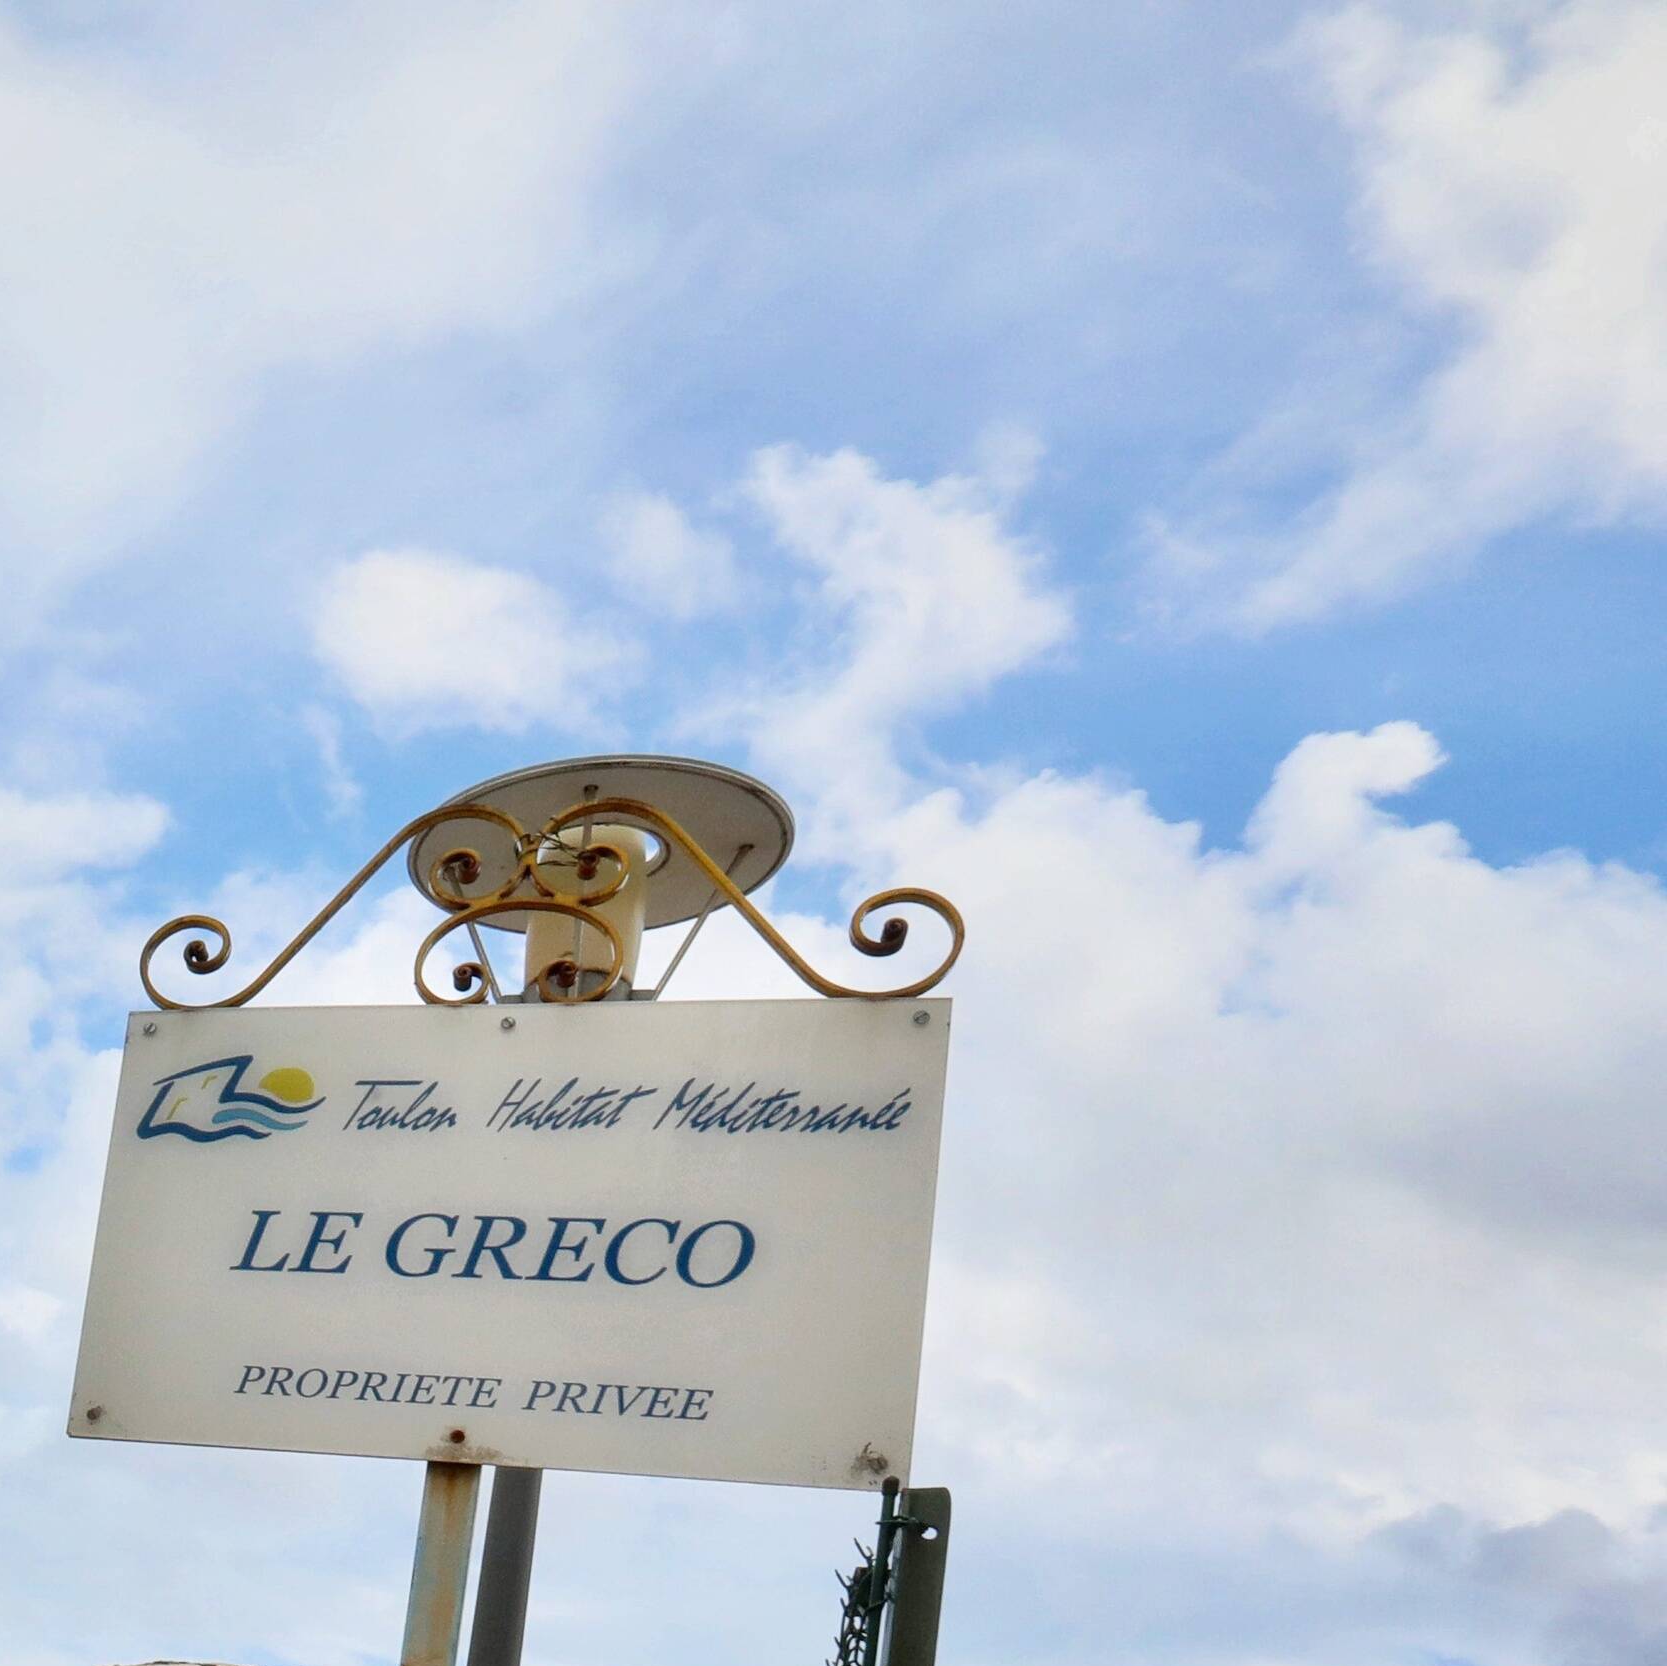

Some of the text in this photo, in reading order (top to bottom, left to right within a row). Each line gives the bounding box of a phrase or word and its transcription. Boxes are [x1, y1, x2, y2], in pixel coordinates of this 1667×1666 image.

[343, 1077, 912, 1135] Toulon Habitat Méditerranée
[229, 1209, 757, 1288] LE GRECO
[233, 1365, 715, 1421] PROPRIETE PRIVEE
